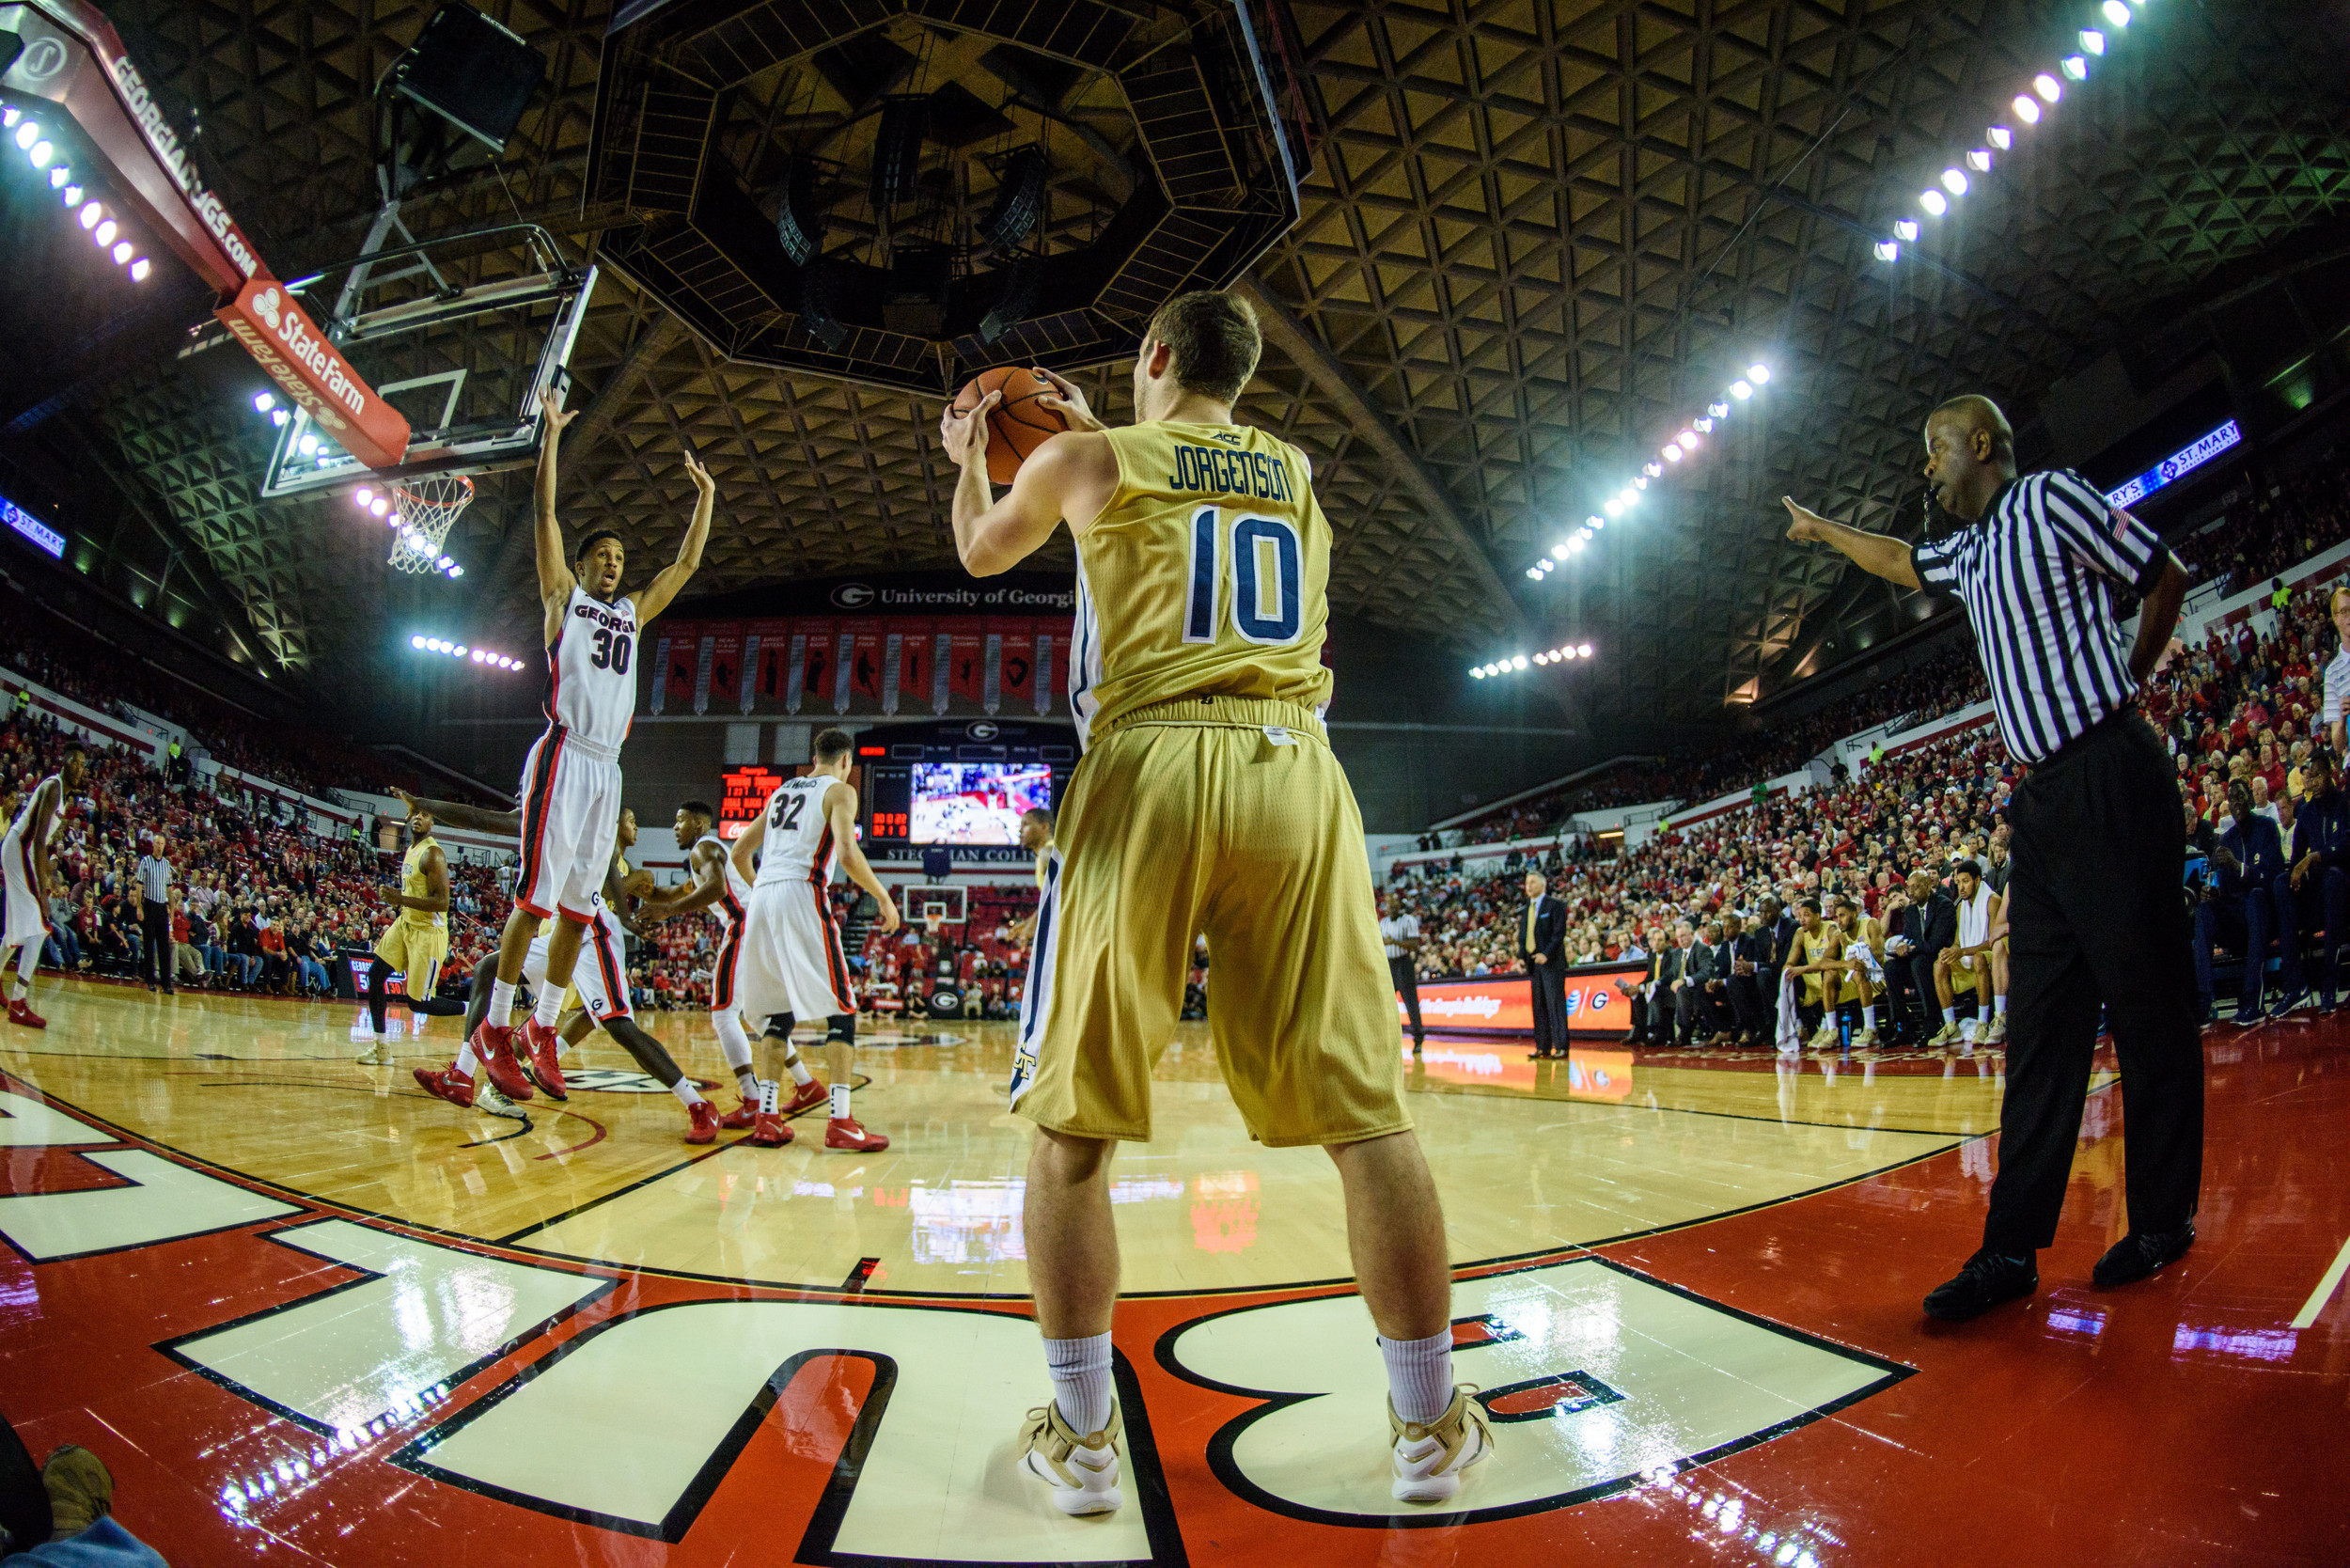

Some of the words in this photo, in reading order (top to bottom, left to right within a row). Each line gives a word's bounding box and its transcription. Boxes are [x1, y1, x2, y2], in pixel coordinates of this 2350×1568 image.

[1169, 445, 1293, 503] JORGENSON
[1182, 504, 1304, 646] 10
[574, 604, 636, 634] GEORGI
[881, 589, 980, 607] University
[984, 588, 1005, 604] of
[1008, 589, 1076, 607] Georgi
[590, 628, 632, 676] 30
[771, 792, 806, 831] 32
